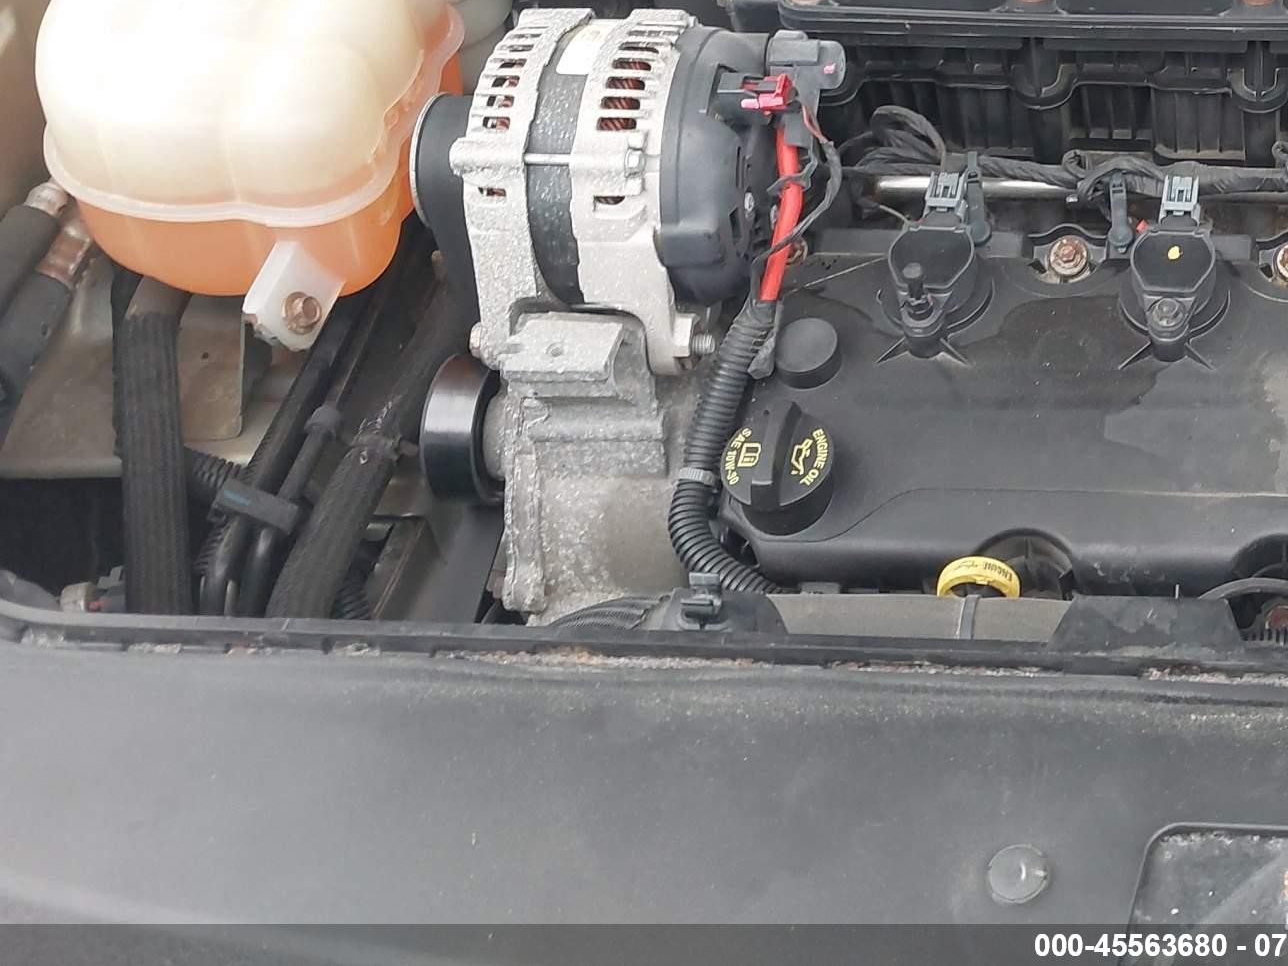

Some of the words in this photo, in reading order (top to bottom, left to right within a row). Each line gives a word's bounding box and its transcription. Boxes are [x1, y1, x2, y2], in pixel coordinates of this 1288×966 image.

[730, 428, 752, 450] SAE
[812, 428, 828, 470] ENGINE
[799, 468, 819, 486] OIL
